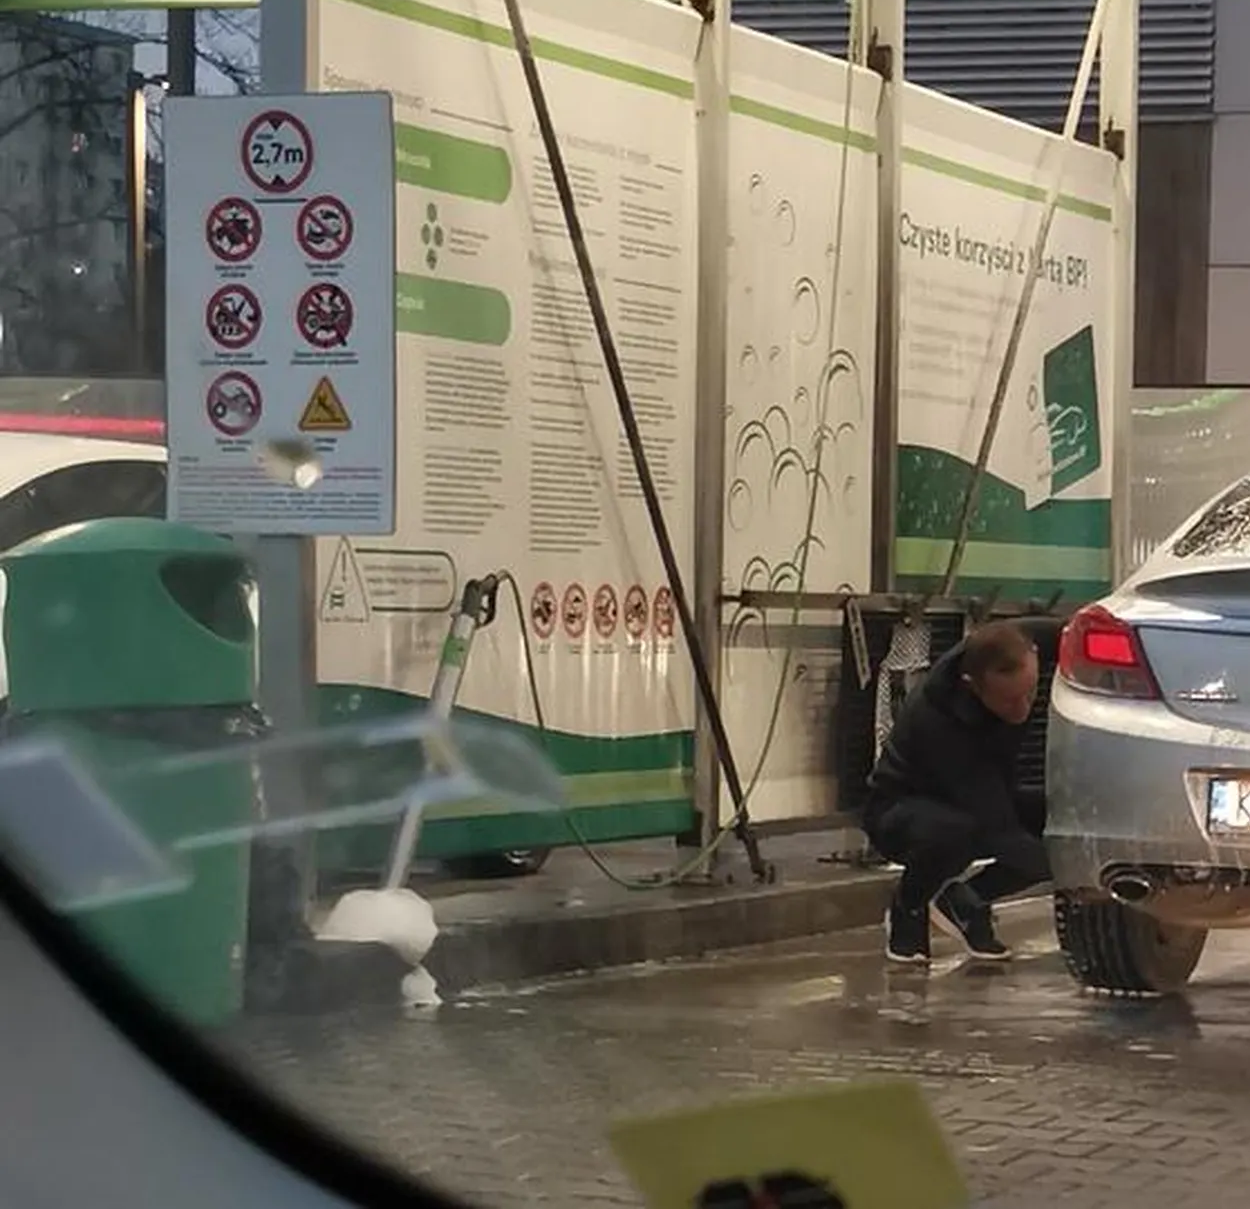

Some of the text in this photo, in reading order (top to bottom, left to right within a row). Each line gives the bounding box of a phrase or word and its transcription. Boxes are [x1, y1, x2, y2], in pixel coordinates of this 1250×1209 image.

[251, 142, 304, 168] 2,7m
[900, 212, 951, 259] Czyste
[954, 225, 1015, 276] korzyści
[1017, 250, 1026, 275] z
